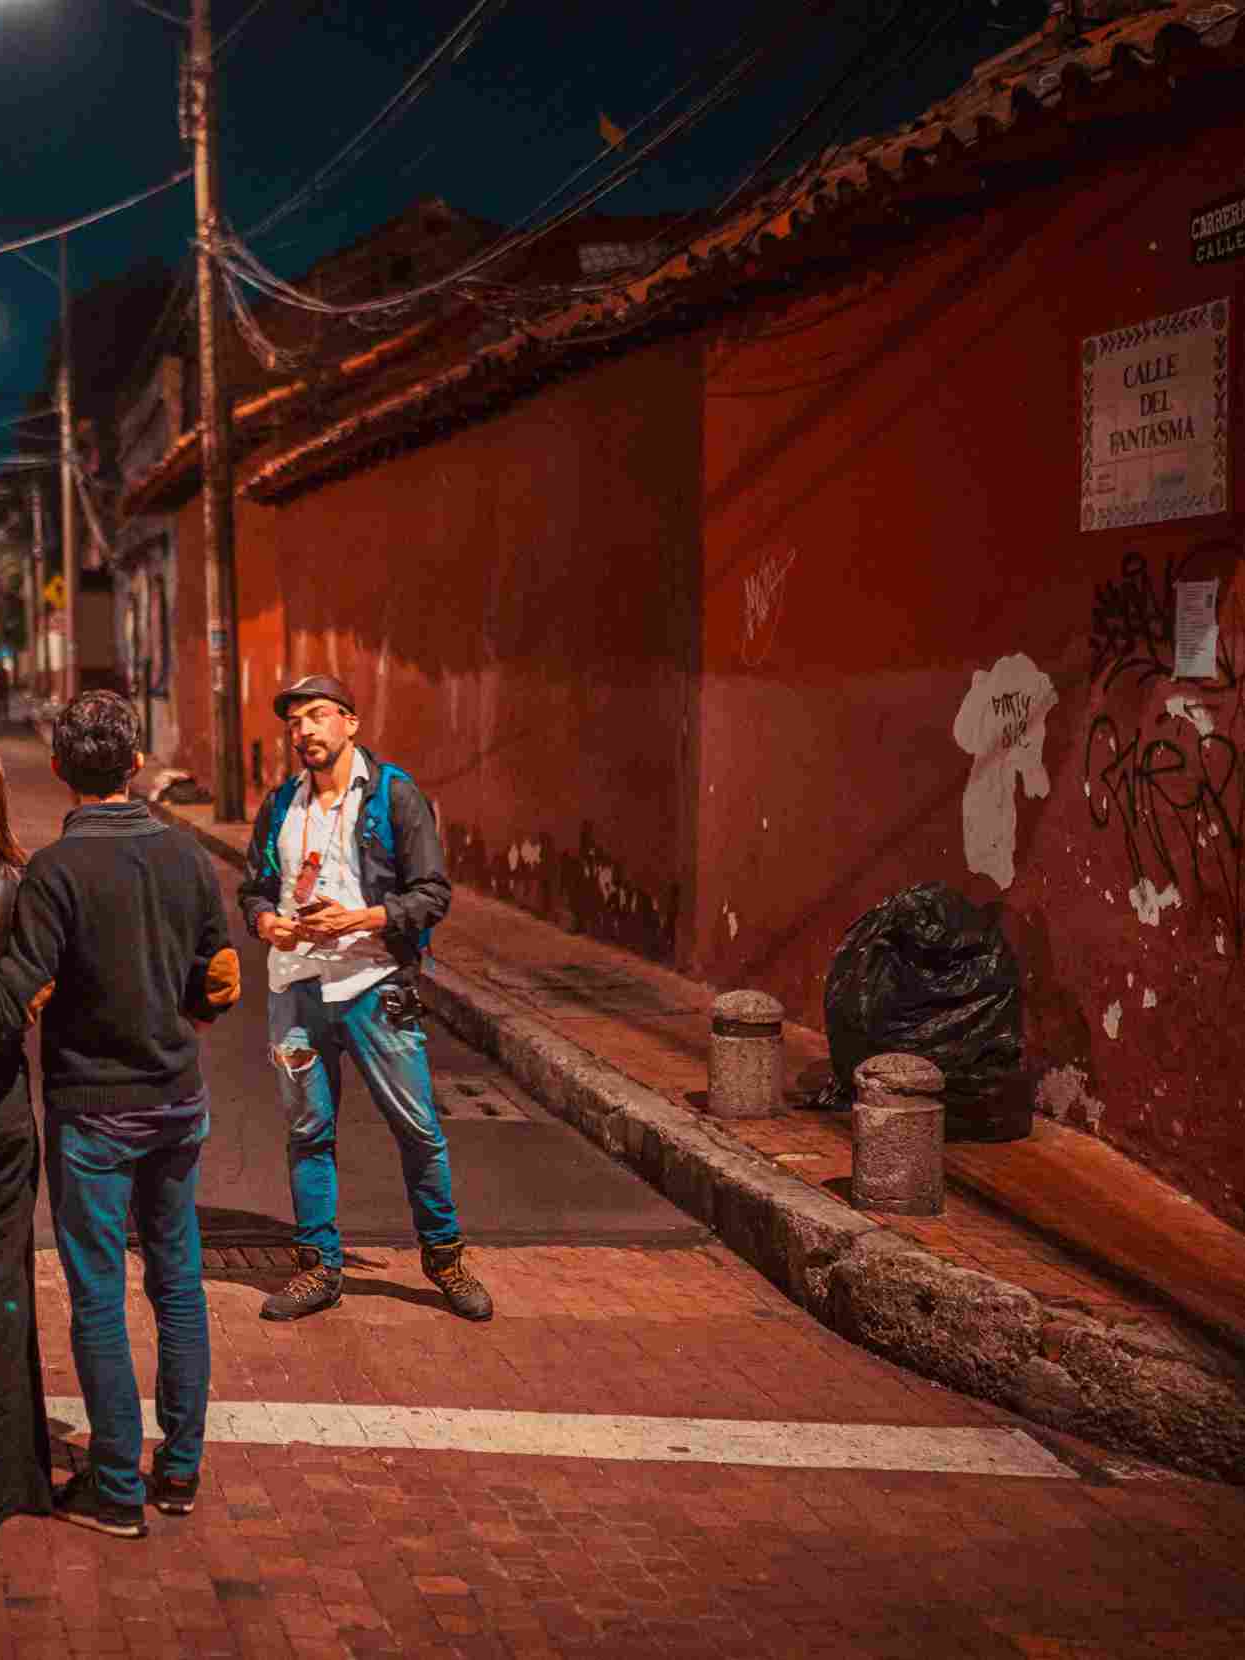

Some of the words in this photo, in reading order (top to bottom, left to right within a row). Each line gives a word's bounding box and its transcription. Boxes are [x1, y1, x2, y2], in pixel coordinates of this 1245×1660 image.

[1196, 231, 1245, 263] CALLE
[1123, 352, 1179, 388] CALLE
[1140, 390, 1171, 416] DEL
[1109, 416, 1195, 456] FANTASMA
